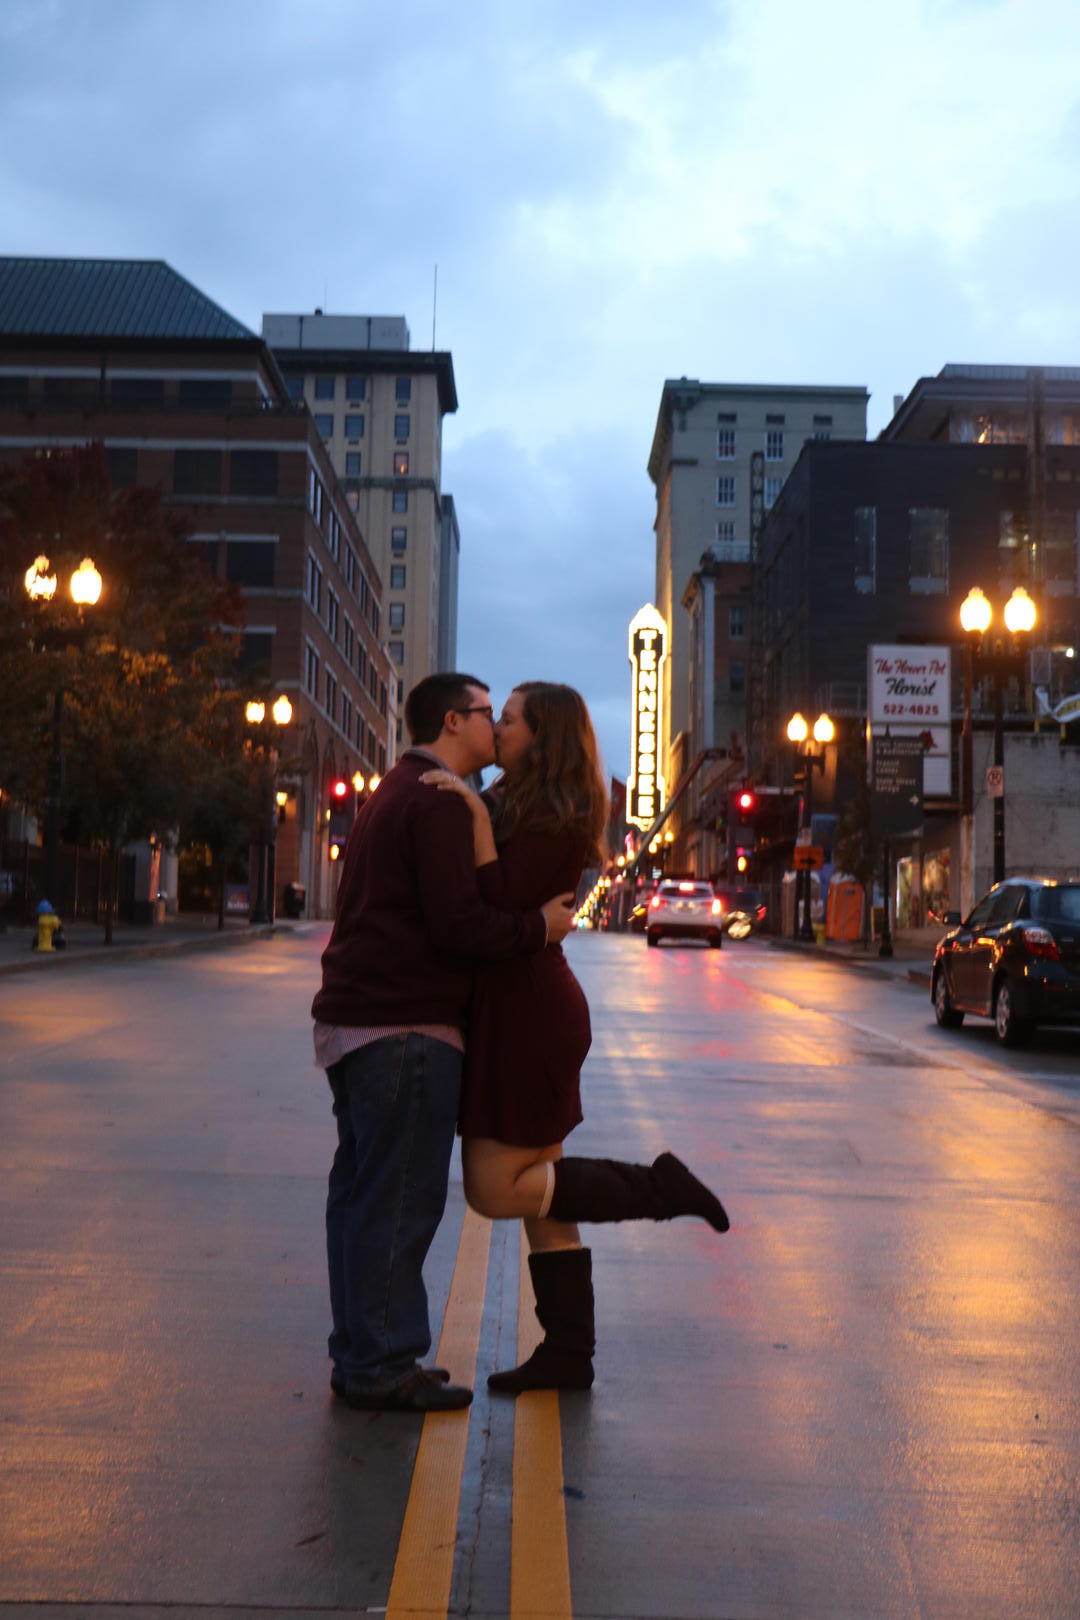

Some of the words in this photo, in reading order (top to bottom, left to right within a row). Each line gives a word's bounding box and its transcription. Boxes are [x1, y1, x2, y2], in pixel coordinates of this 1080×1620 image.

[875, 658, 893, 674] The
[894, 658, 926, 674] Flower
[929, 658, 946, 674] Pot
[885, 677, 937, 696] Florist
[638, 629, 657, 817] TENNESSEE
